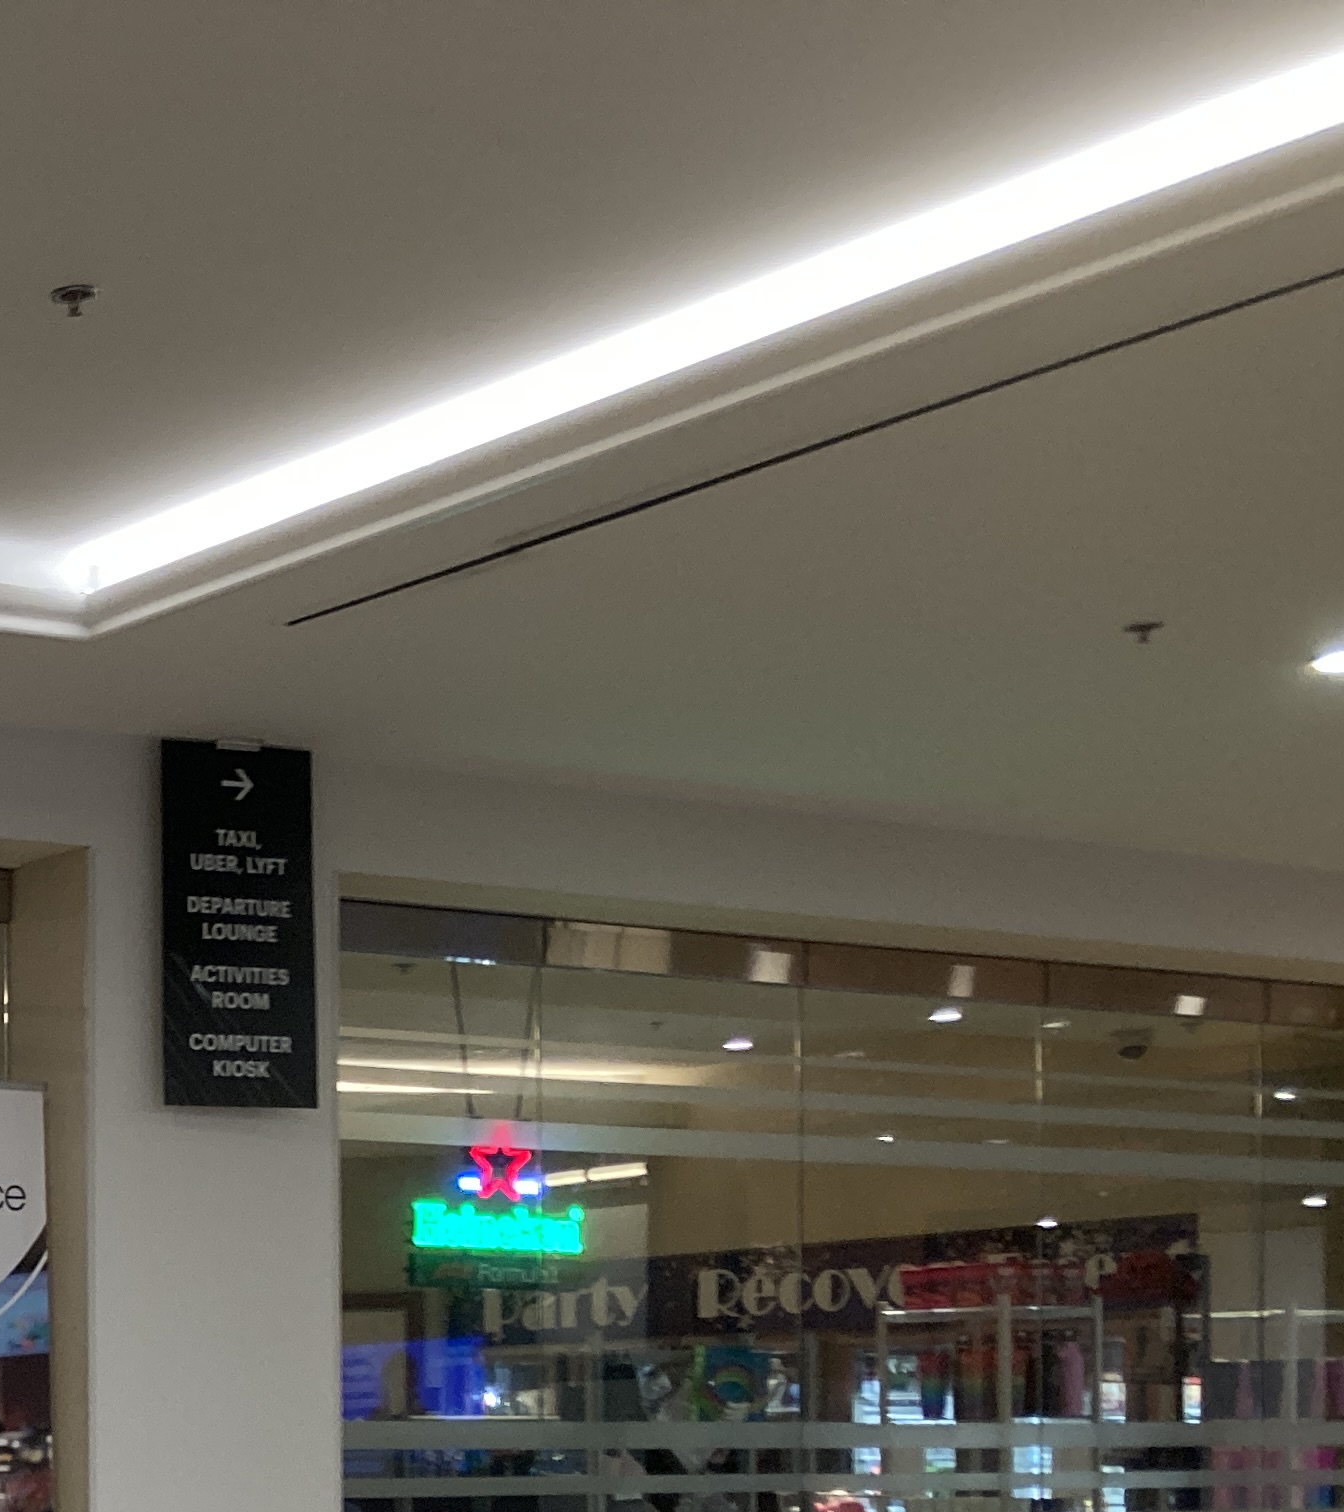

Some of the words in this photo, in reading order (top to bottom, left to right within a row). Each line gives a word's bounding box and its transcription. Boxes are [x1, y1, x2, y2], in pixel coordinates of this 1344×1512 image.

[215, 828, 261, 850] TAXI,
[190, 853, 243, 875] UBER,
[246, 856, 288, 876] LYFT
[186, 896, 293, 918] DEPARTURE
[201, 922, 279, 943] LOUNGE
[190, 965, 290, 986] ACTIVITIES
[211, 991, 270, 1010] ROOM
[188, 1034, 293, 1054] COMPUTER
[212, 1060, 270, 1078] KIOSK
[482, 1276, 649, 1334] Party
